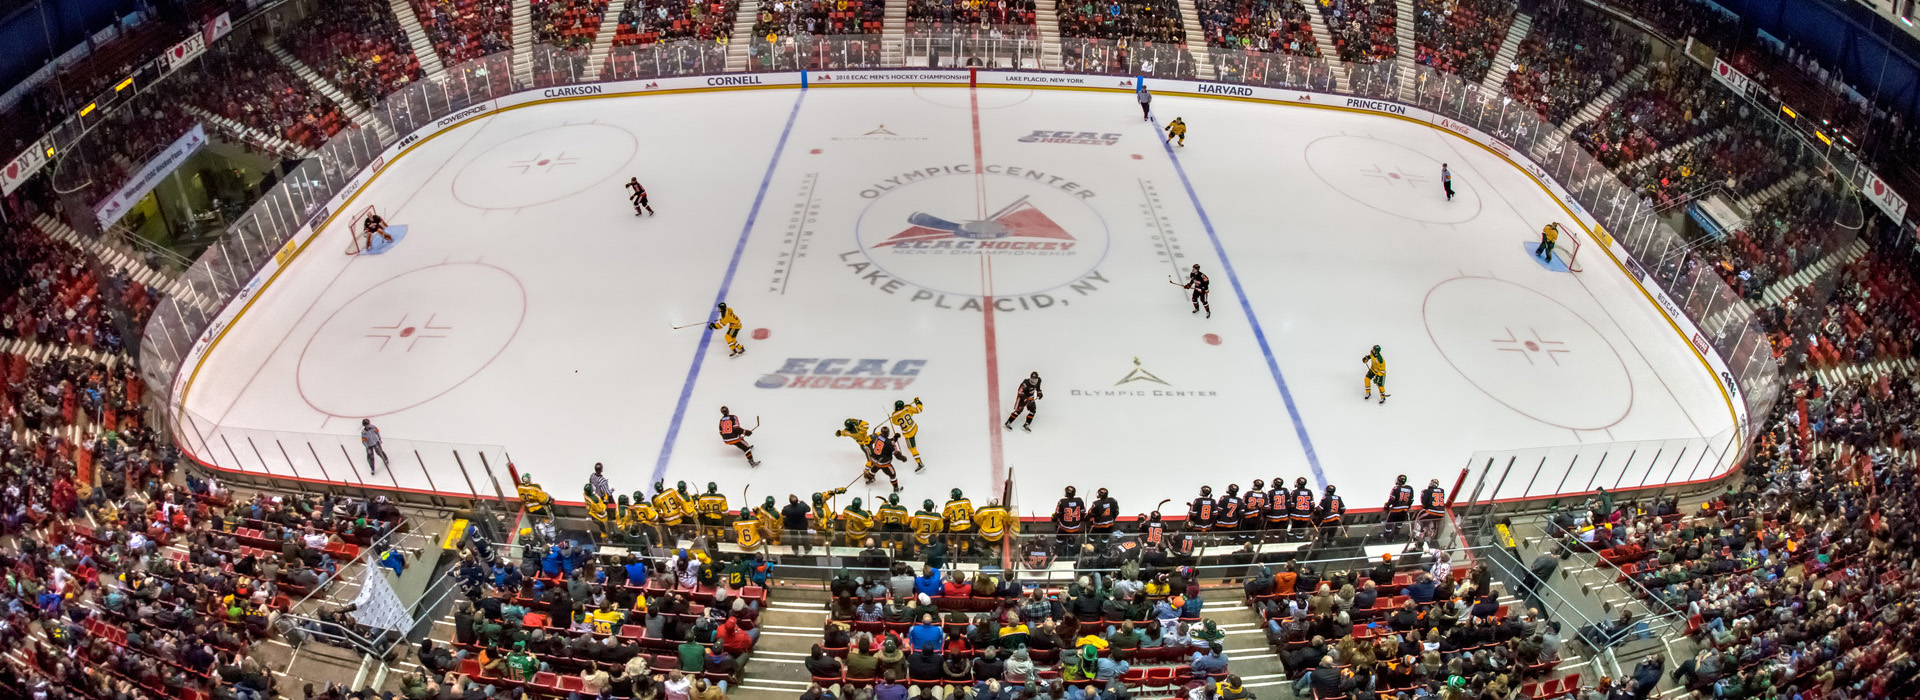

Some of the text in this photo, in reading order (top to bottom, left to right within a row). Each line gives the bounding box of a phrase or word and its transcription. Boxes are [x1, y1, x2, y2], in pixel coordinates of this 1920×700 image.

[184, 34, 201, 55] NY
[707, 75, 762, 86] CORNELL
[1727, 69, 1746, 88] NY
[544, 85, 602, 98] CLARKSON
[1198, 83, 1253, 97] HARVARD
[1346, 98, 1406, 115] PRINCETON
[437, 104, 486, 128] POWERADE
[1029, 130, 1122, 140] ECAC
[17, 144, 40, 172] NY
[859, 164, 1096, 200] OLYMPIC CENTER
[1883, 188, 1906, 214] NY
[893, 240, 1076, 251] ECAC HOCKEY
[839, 250, 1110, 313] LAKE PLACID, NY
[1657, 293, 1680, 319] BOXCAST
[775, 358, 928, 376] ECAC
[787, 375, 916, 390] HOCKEY
[897, 413, 913, 430] 28
[663, 497, 678, 514] 19
[1274, 495, 1286, 509] 21
[1296, 496, 1311, 510] 25
[1432, 492, 1444, 506] 35
[1063, 506, 1080, 521] 24
[1201, 505, 1211, 520] 8
[1227, 503, 1237, 517] 7
[1330, 500, 1339, 513] 9
[951, 508, 966, 521] 13
[922, 523, 931, 533] 3
[990, 516, 995, 528] 1
[742, 529, 752, 543] 6
[1147, 527, 1162, 542] 16
[1182, 540, 1193, 553] 11
[704, 569, 713, 579] 3
[730, 572, 741, 584] 12
